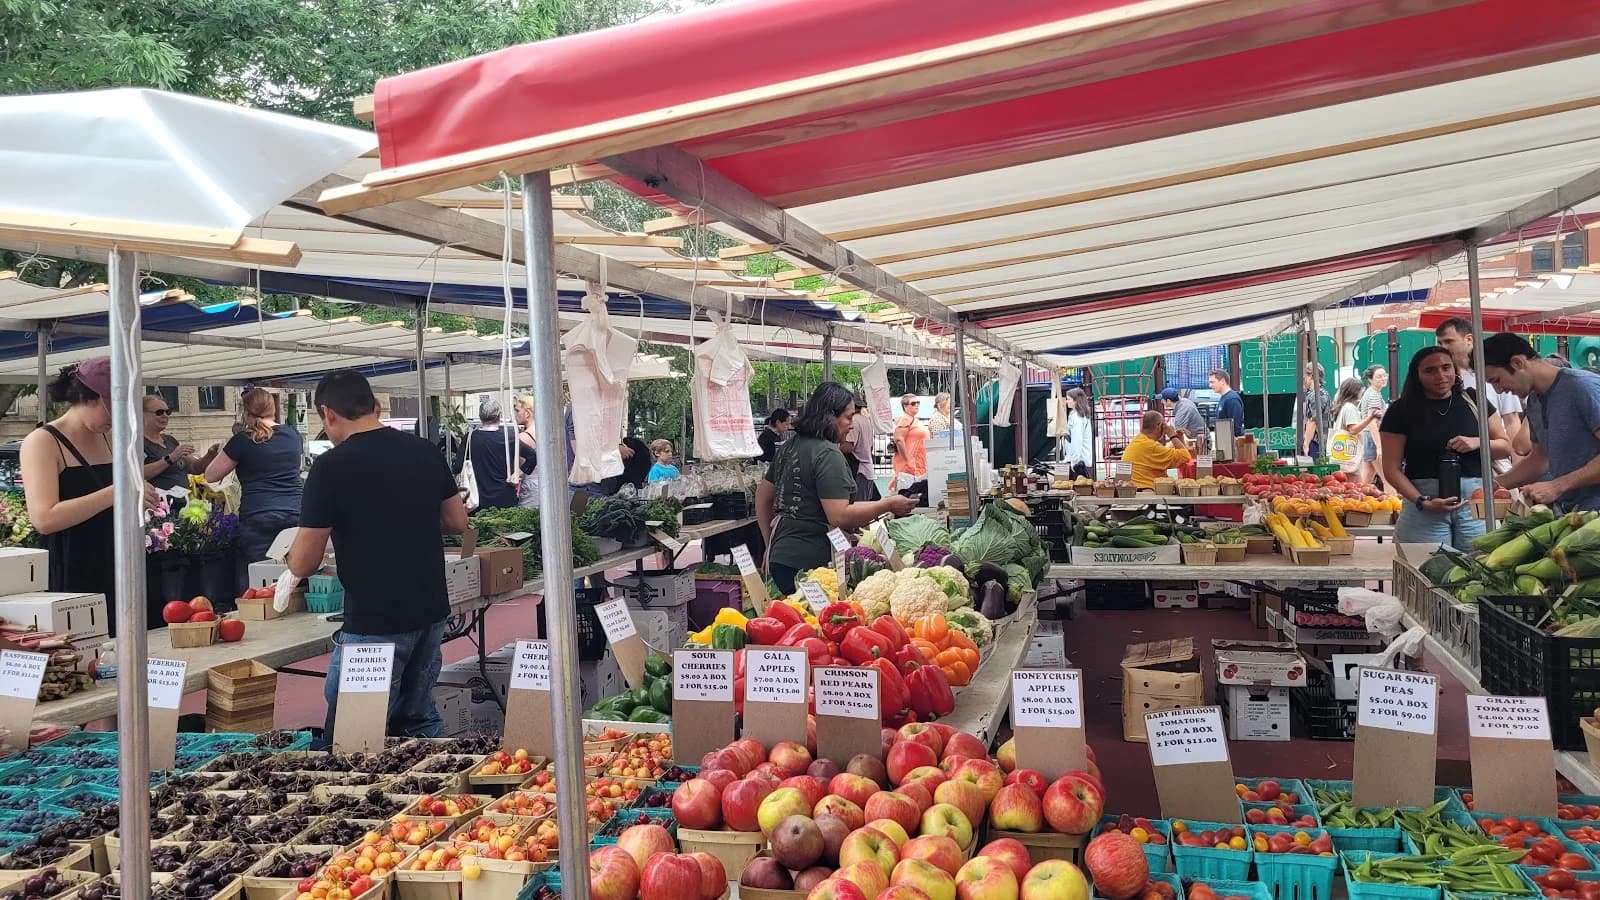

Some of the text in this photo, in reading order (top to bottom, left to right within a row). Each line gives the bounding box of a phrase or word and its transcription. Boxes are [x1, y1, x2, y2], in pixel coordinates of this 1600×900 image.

[522, 653, 549, 661] CHERR
[763, 652, 791, 661] GALA
[147, 660, 186, 668] UEBERRIES
[758, 664, 795, 673] APPLES
[824, 670, 868, 678] CRIMSON
[1014, 672, 1078, 680] HONEYCRISP
[1363, 670, 1402, 682] SUGAR
[842, 681, 873, 689] PEARS
[1384, 685, 1414, 695] PEAS
[854, 691, 871, 699] BOX
[1369, 696, 1394, 705] $5.00
[1406, 700, 1428, 709] BOX
[1474, 705, 1540, 713] TOMATOES
[1147, 708, 1216, 720] BABY HEIRLOOM
[1378, 708, 1398, 717] FOR
[1401, 712, 1427, 720] $9.00
[1160, 717, 1206, 726] TOMATOES
[1156, 729, 1180, 738] $6.00
[1186, 737, 1217, 745] $11.00
